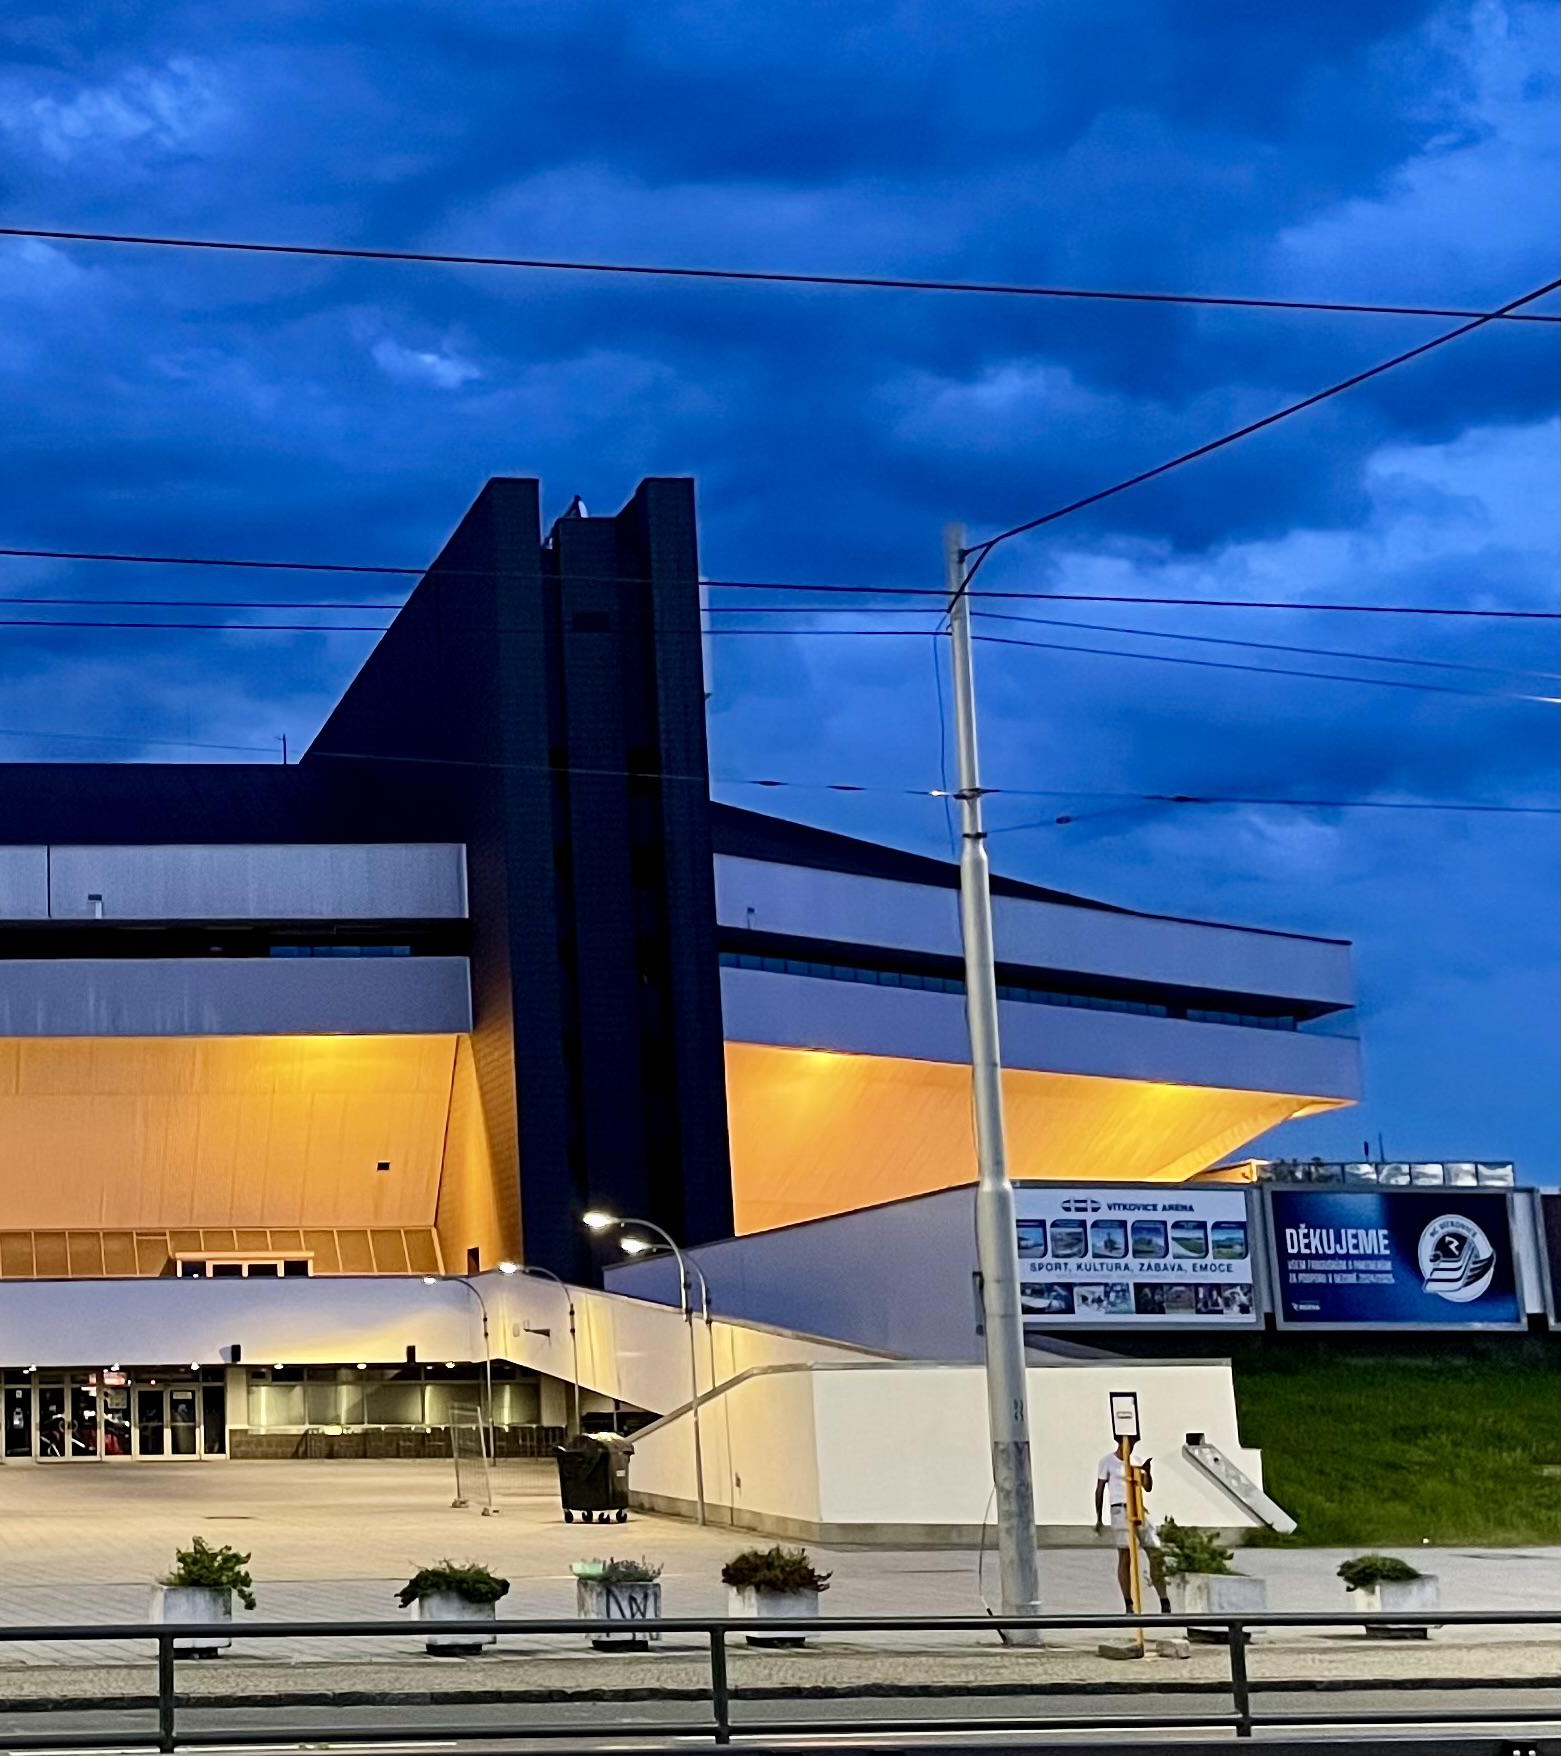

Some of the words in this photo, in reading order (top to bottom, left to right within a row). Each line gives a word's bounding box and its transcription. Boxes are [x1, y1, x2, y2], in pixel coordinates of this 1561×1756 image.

[1285, 1223, 1391, 1255] DĚKUJEME
[1030, 1263, 1072, 1273] SPORT,
[1076, 1263, 1134, 1273] KULTURA,
[1139, 1260, 1188, 1274] ZÁBAVA,
[1192, 1264, 1233, 1273] EMOCE
